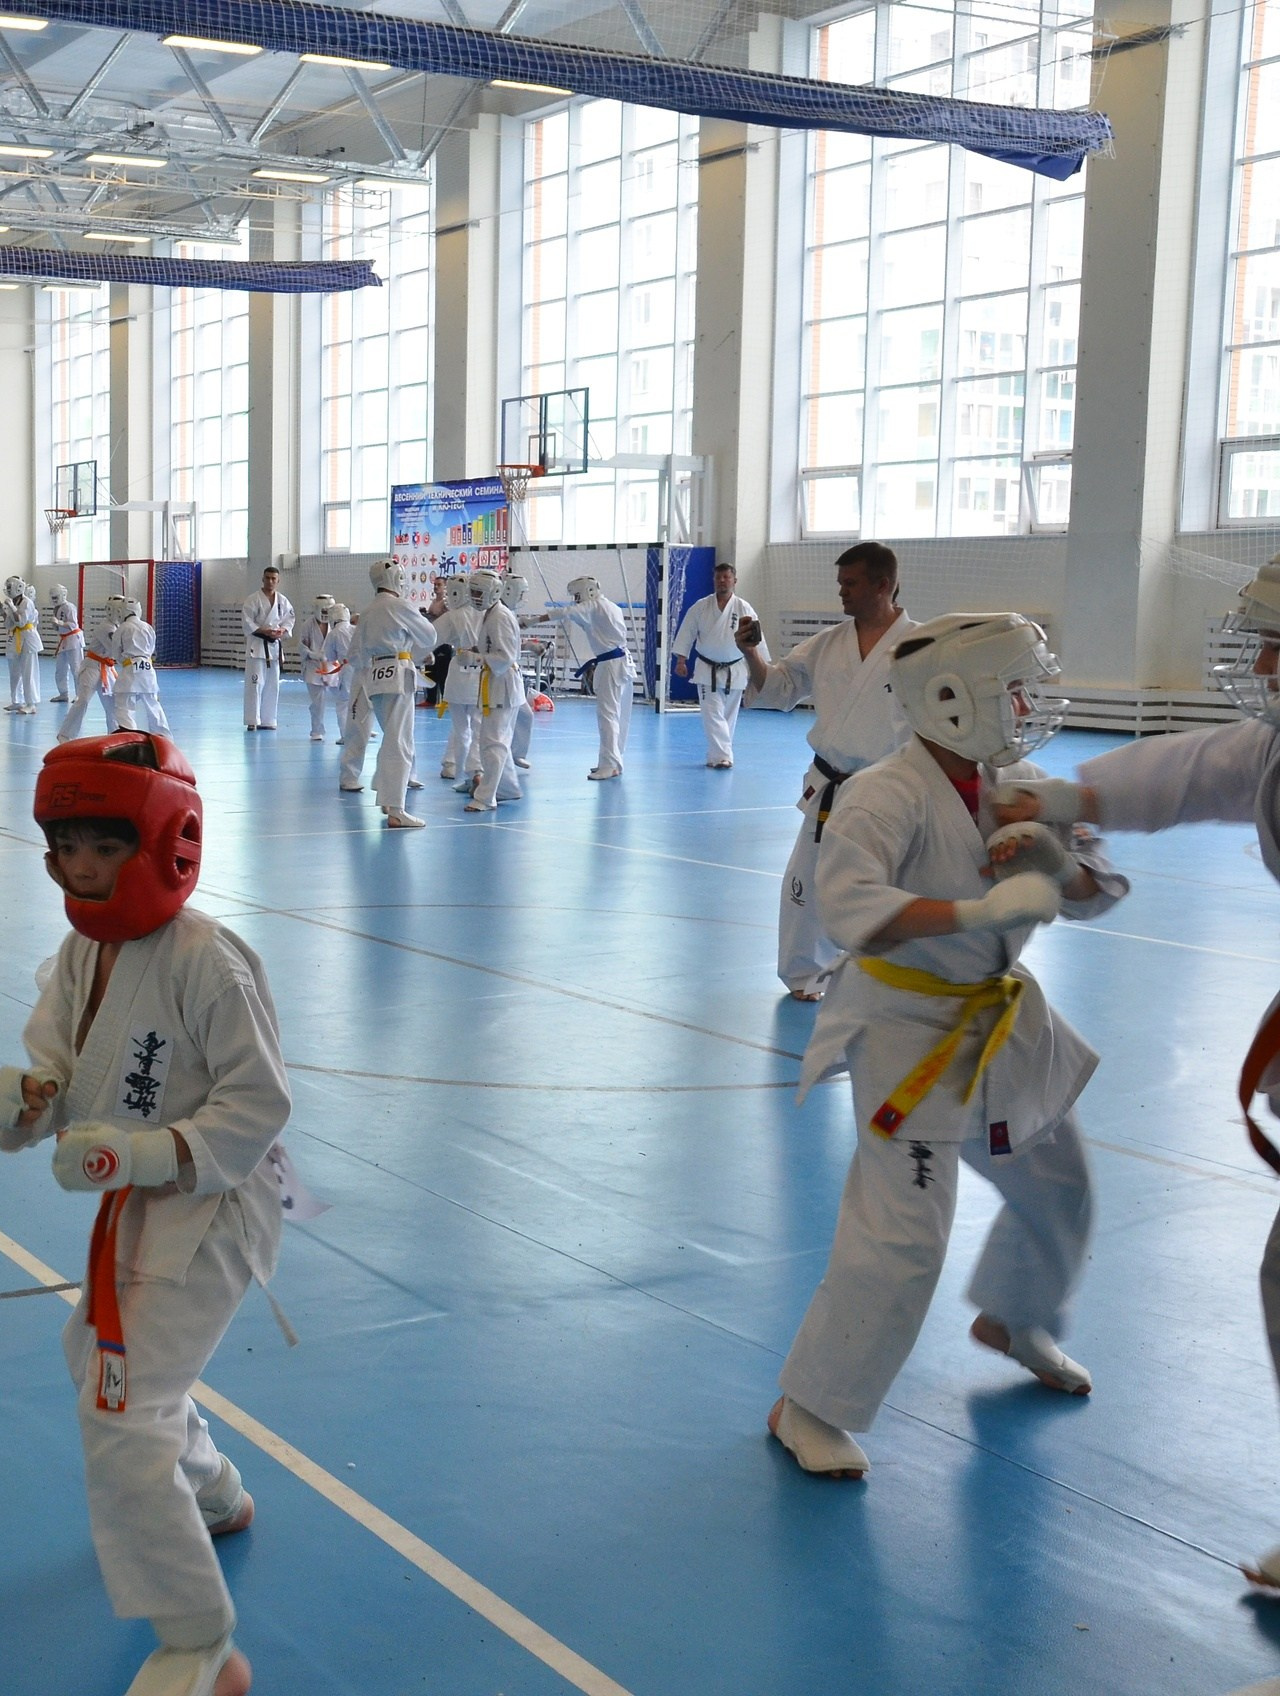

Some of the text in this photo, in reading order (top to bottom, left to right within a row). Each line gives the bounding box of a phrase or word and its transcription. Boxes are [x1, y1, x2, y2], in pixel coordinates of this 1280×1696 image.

[428, 486, 473, 499] ТЕХНИЧЕСКИЙ
[474, 485, 505, 496] СЕМИНА
[132, 660, 152, 671] 149
[371, 665, 395, 681] 165
